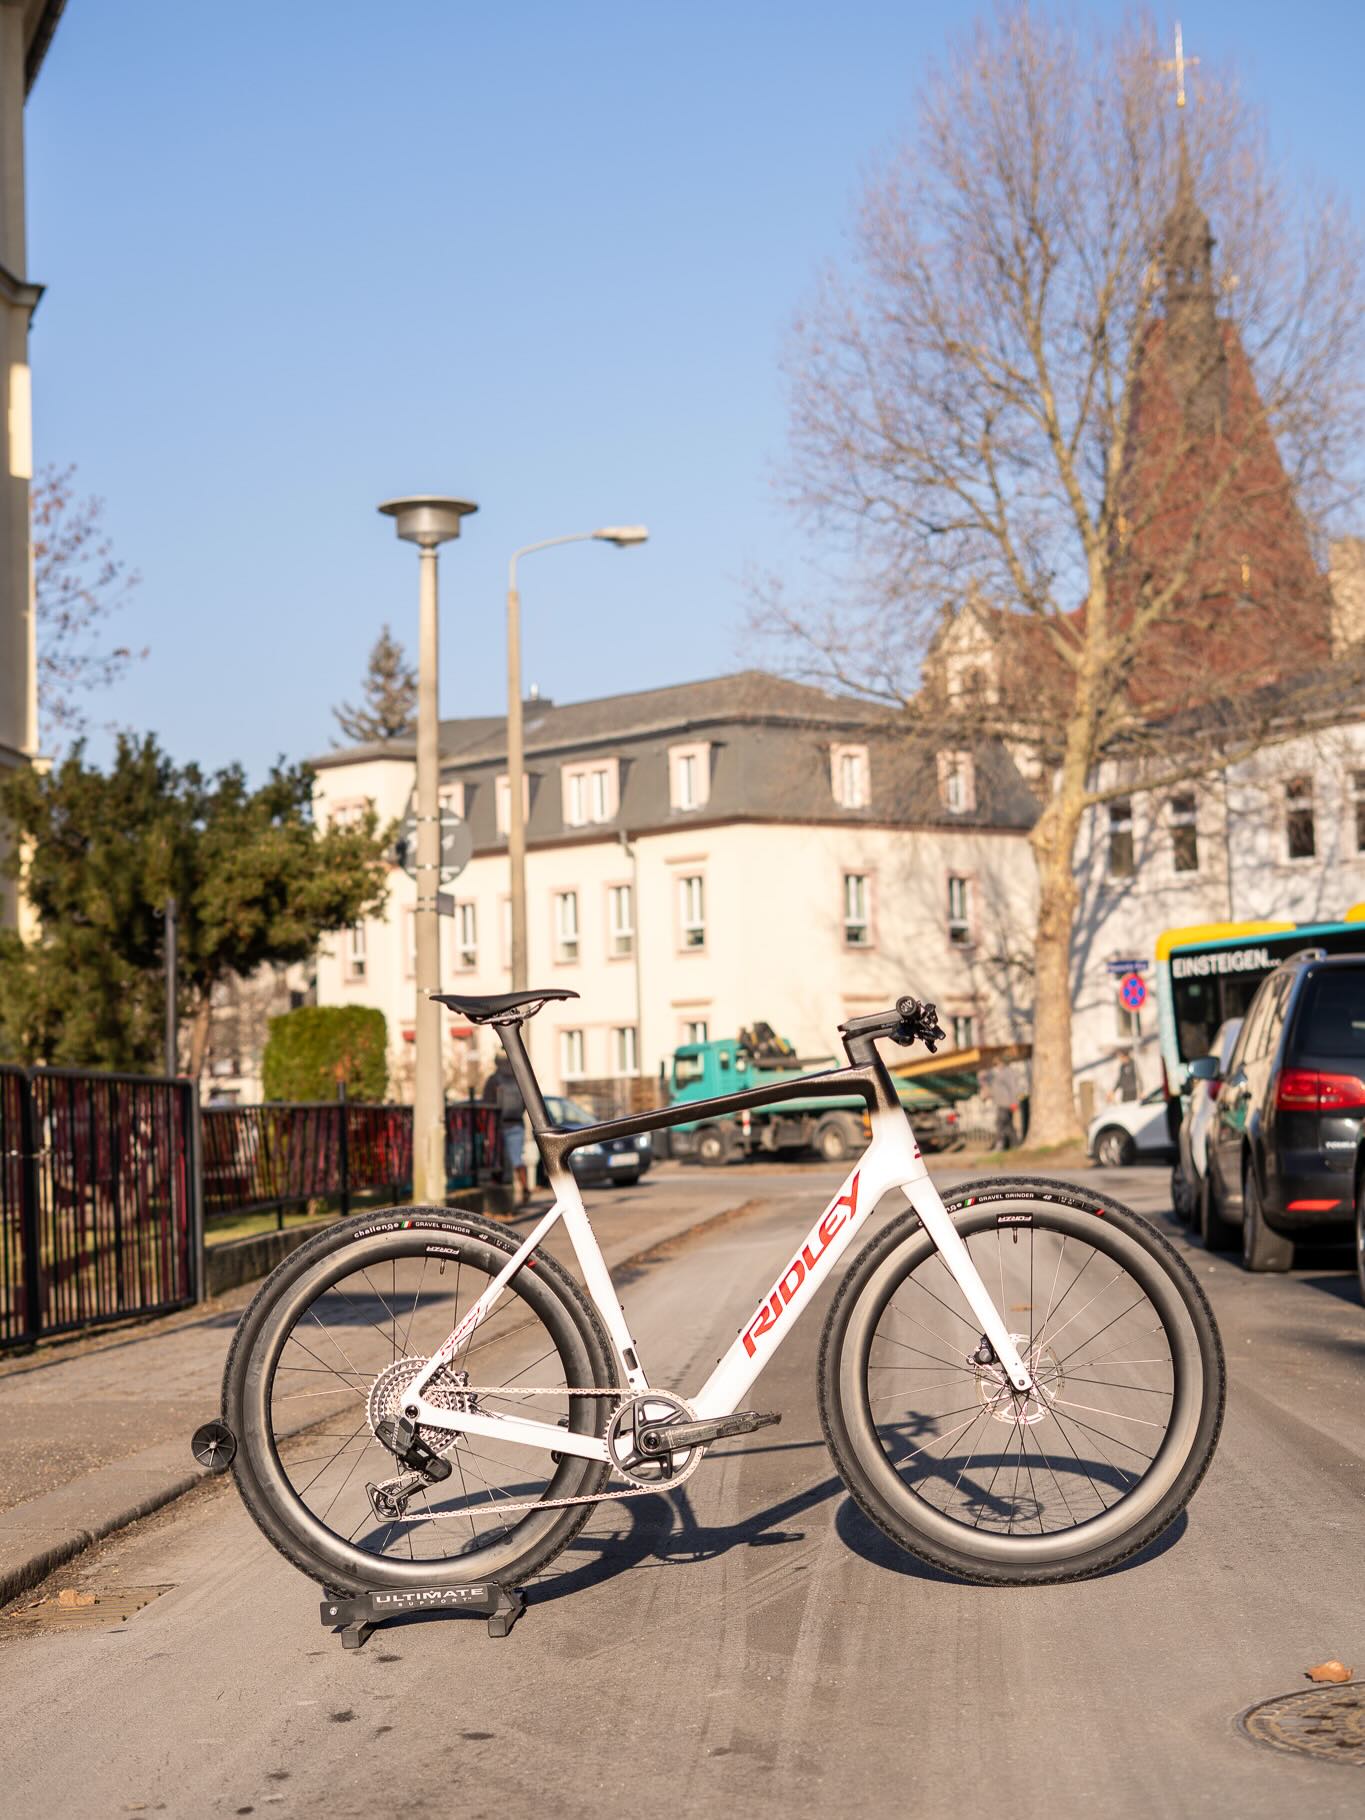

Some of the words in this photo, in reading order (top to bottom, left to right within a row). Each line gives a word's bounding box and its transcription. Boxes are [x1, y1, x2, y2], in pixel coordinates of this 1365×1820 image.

[978, 1194, 1004, 1202] GRAVEL
[997, 1215, 1032, 1223] FORZA
[354, 1222, 400, 1239] challenge
[415, 1221, 440, 1229] GRAVEL
[441, 1223, 471, 1235] GRINDER
[426, 1245, 460, 1255] FORZA
[742, 1169, 860, 1358] RIDLEY
[376, 1588, 484, 1603] ULTIMATE
